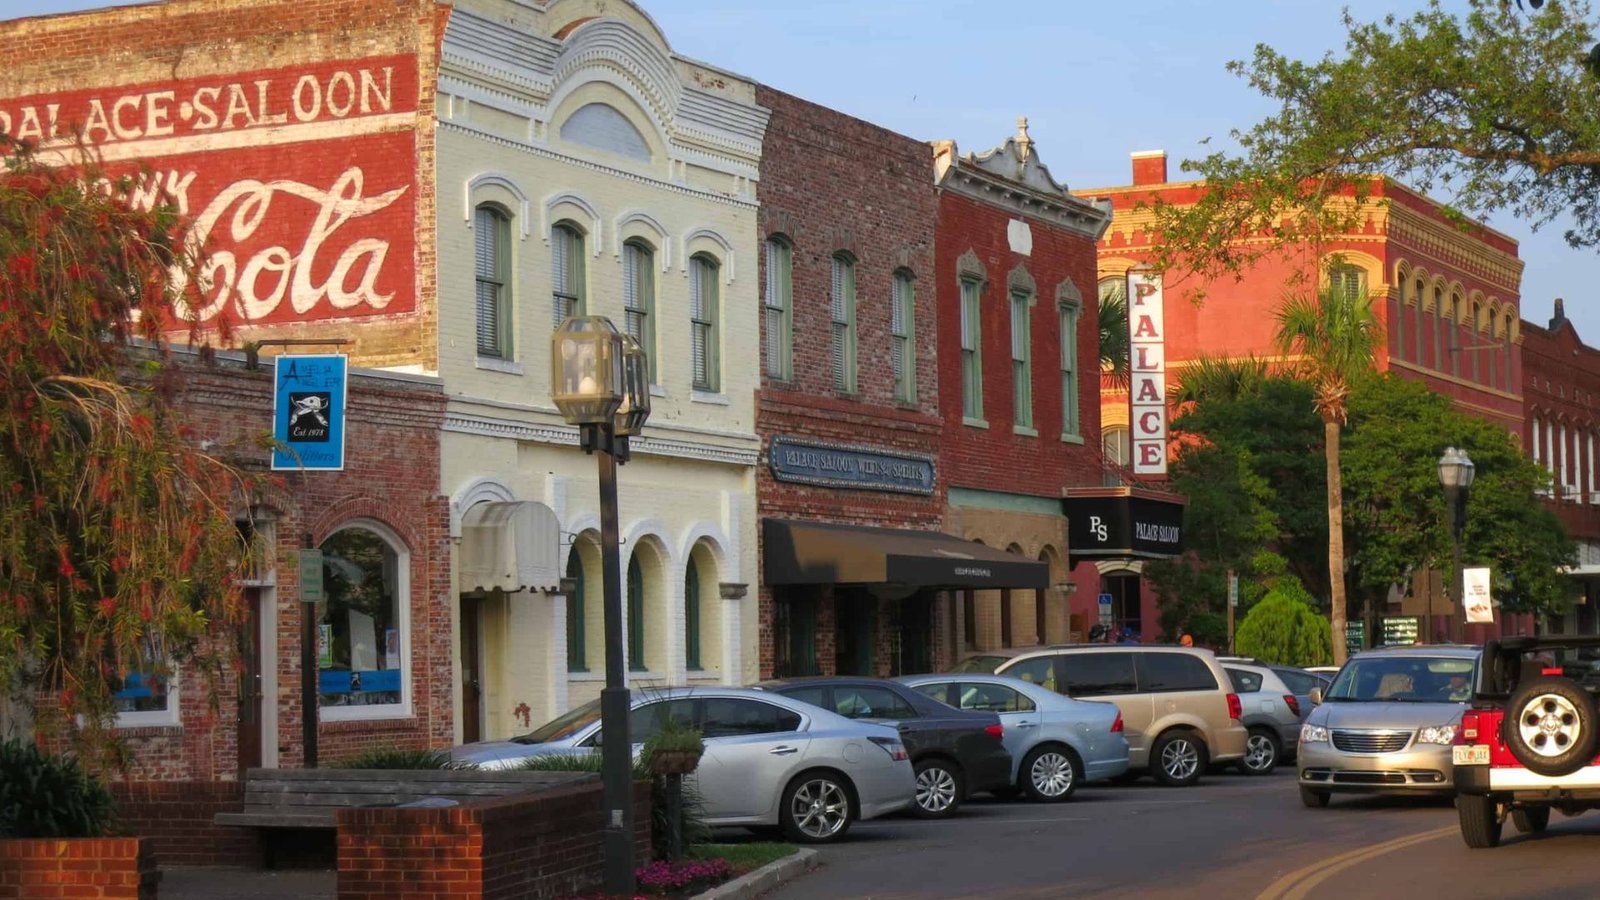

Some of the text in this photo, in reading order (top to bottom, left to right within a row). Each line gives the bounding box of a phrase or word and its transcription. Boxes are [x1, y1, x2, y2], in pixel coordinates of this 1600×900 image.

[193, 67, 394, 131] SALOON
[1134, 283, 1162, 466] PALACE
[1135, 521, 1180, 543] PALACE SALOON
